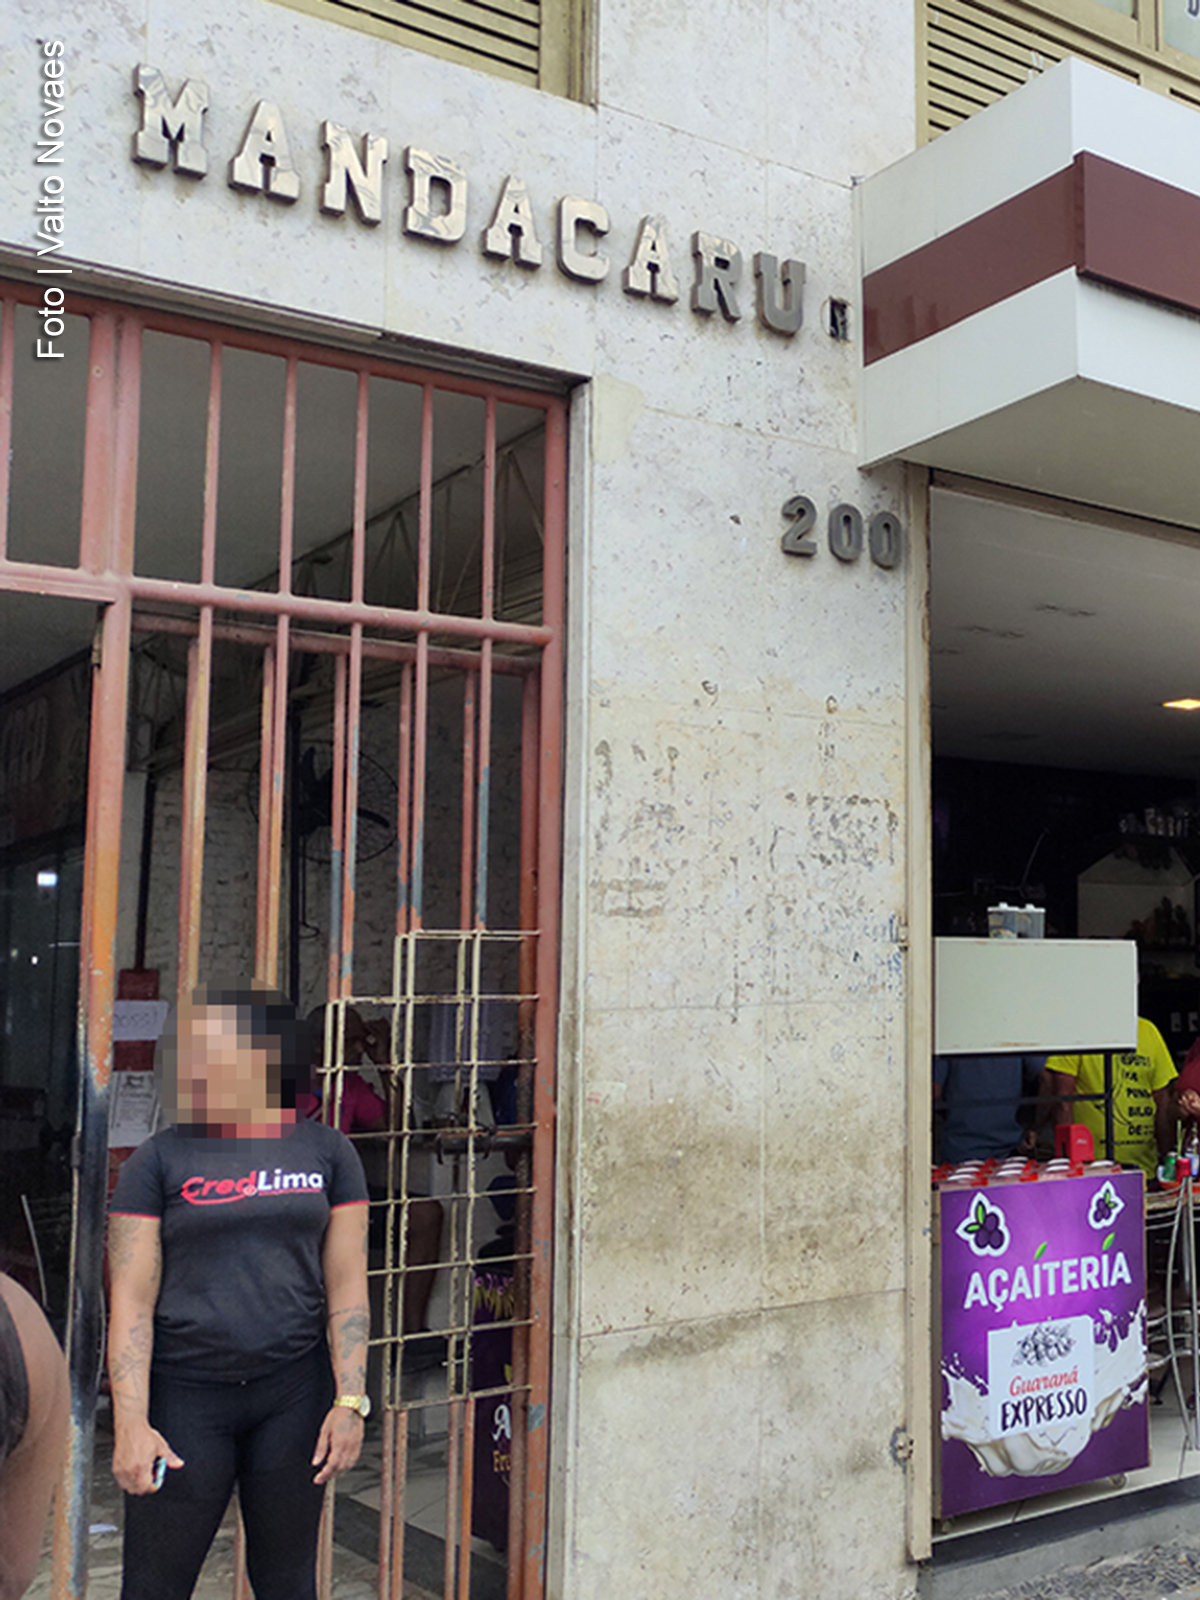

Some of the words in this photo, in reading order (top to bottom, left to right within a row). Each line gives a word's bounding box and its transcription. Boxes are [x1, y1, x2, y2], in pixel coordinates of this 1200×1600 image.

[133, 63, 807, 338] MANDACARU
[780, 495, 903, 571] 200
[1001, 1388, 1088, 1432] EXPRESSO
[1009, 1365, 1079, 1398] Guaraná
